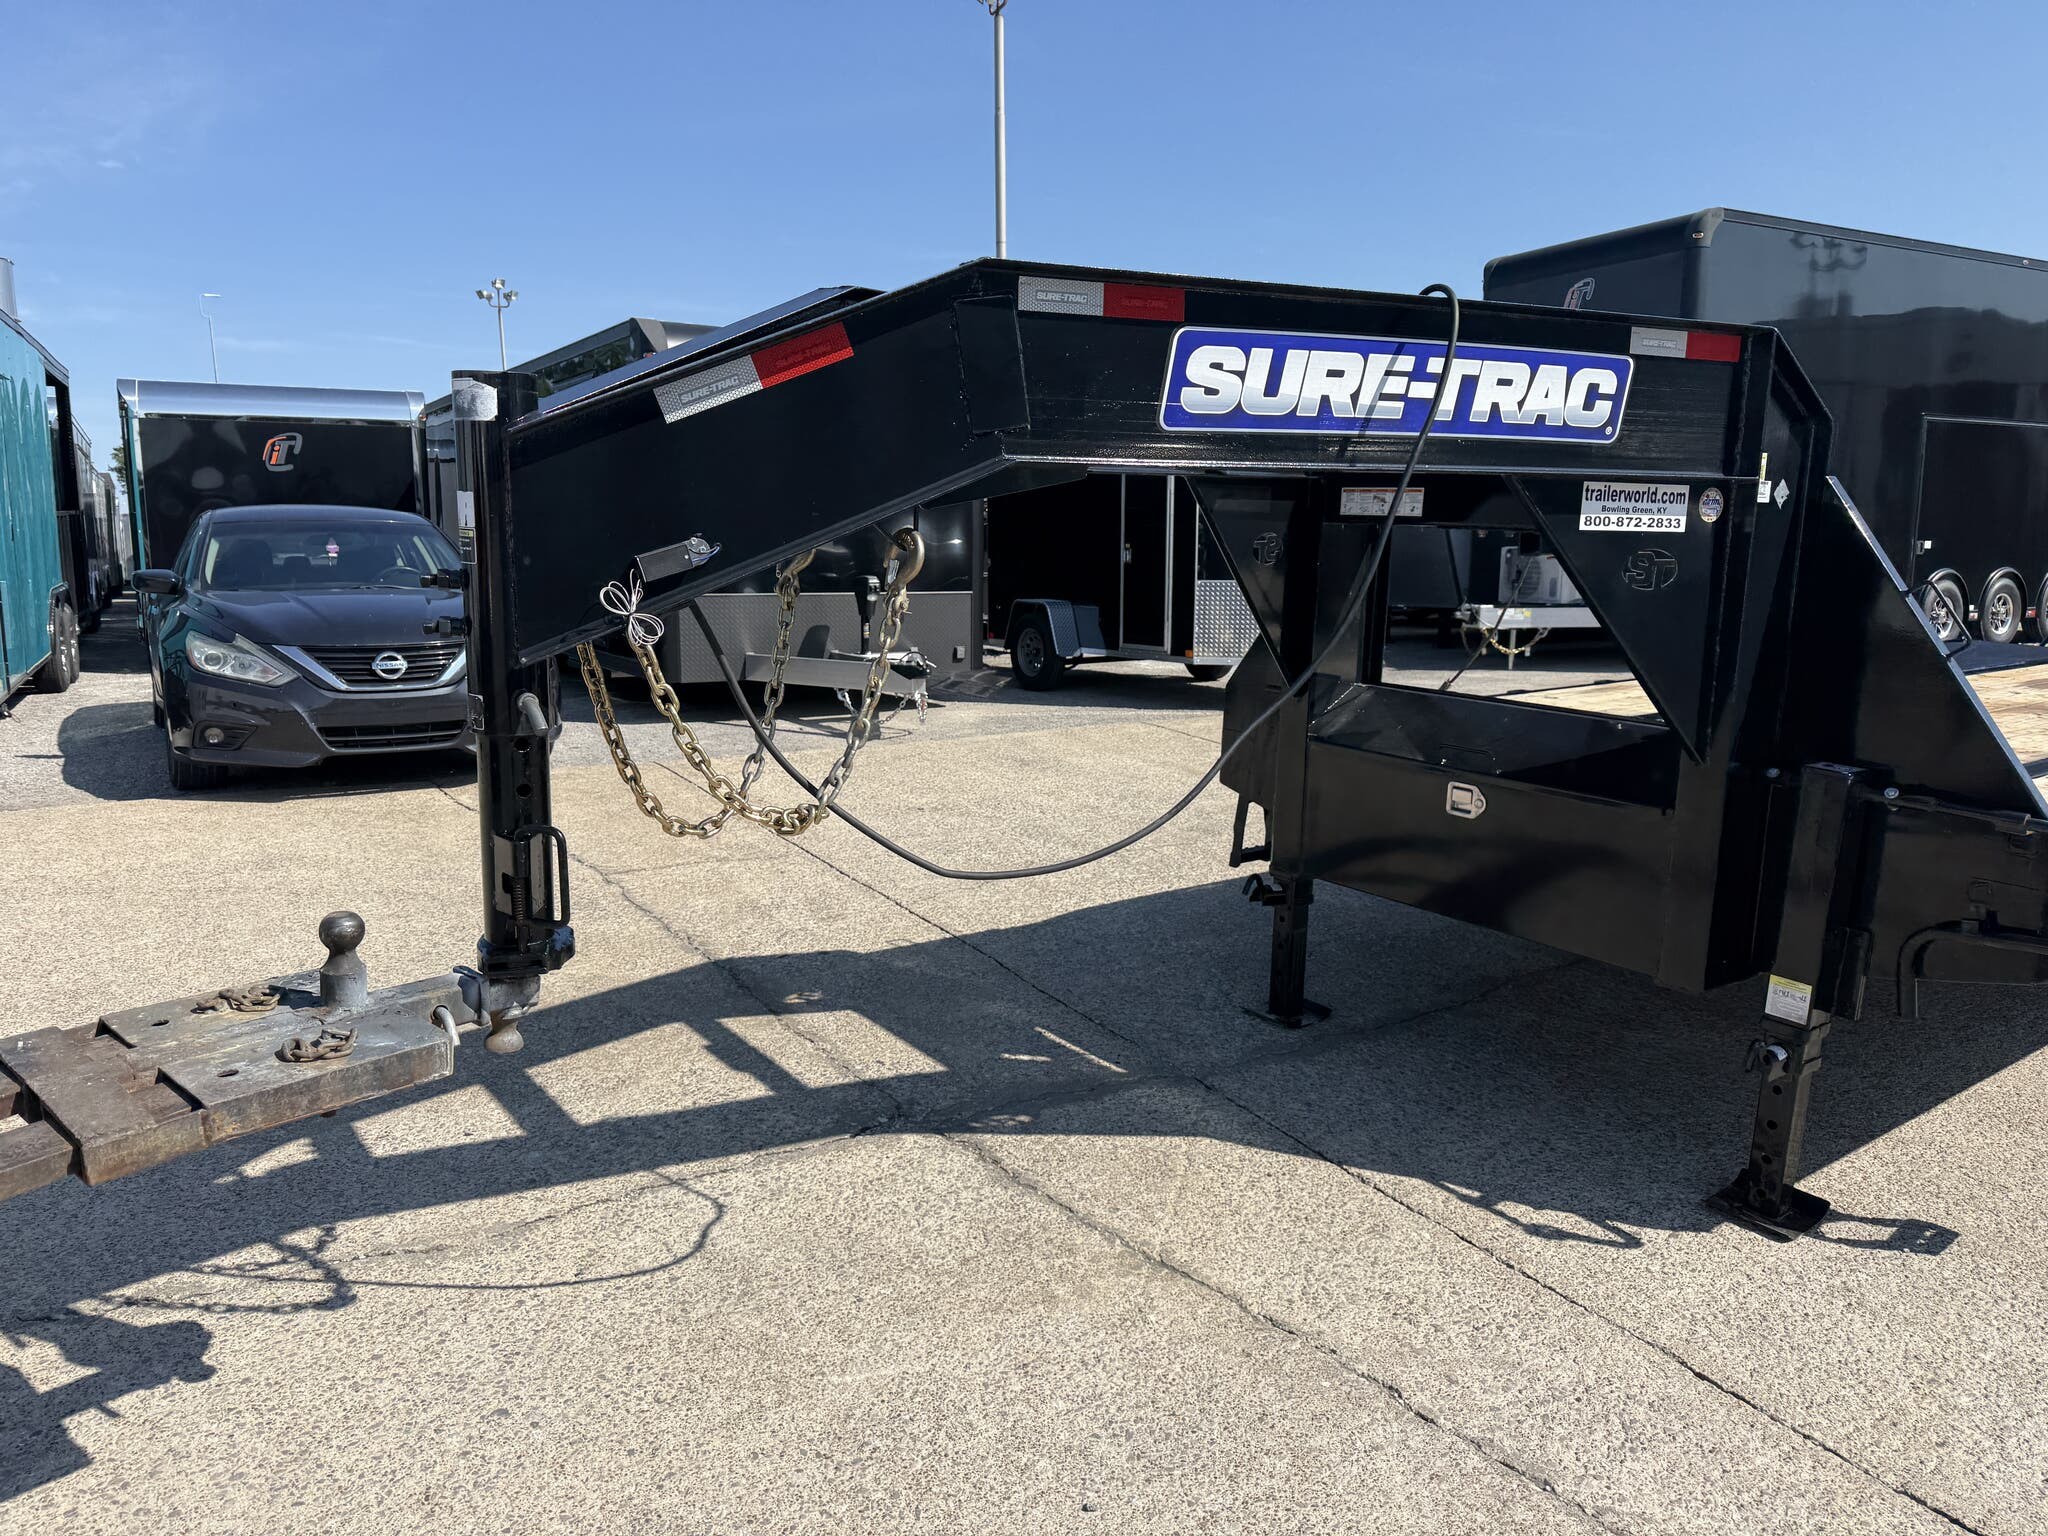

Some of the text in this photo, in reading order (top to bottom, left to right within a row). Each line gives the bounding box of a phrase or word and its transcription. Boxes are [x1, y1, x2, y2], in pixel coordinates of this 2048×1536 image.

[1036, 291, 1088, 303] SURE-TRAC
[680, 375, 740, 402] SURE-TRAC
[1180, 345, 1618, 428] SURE-TRAC
[1585, 484, 1686, 505] trailerworld.com
[1601, 504, 1668, 515] Bowling Green, KY
[1584, 515, 1681, 529] 800-872-2833
